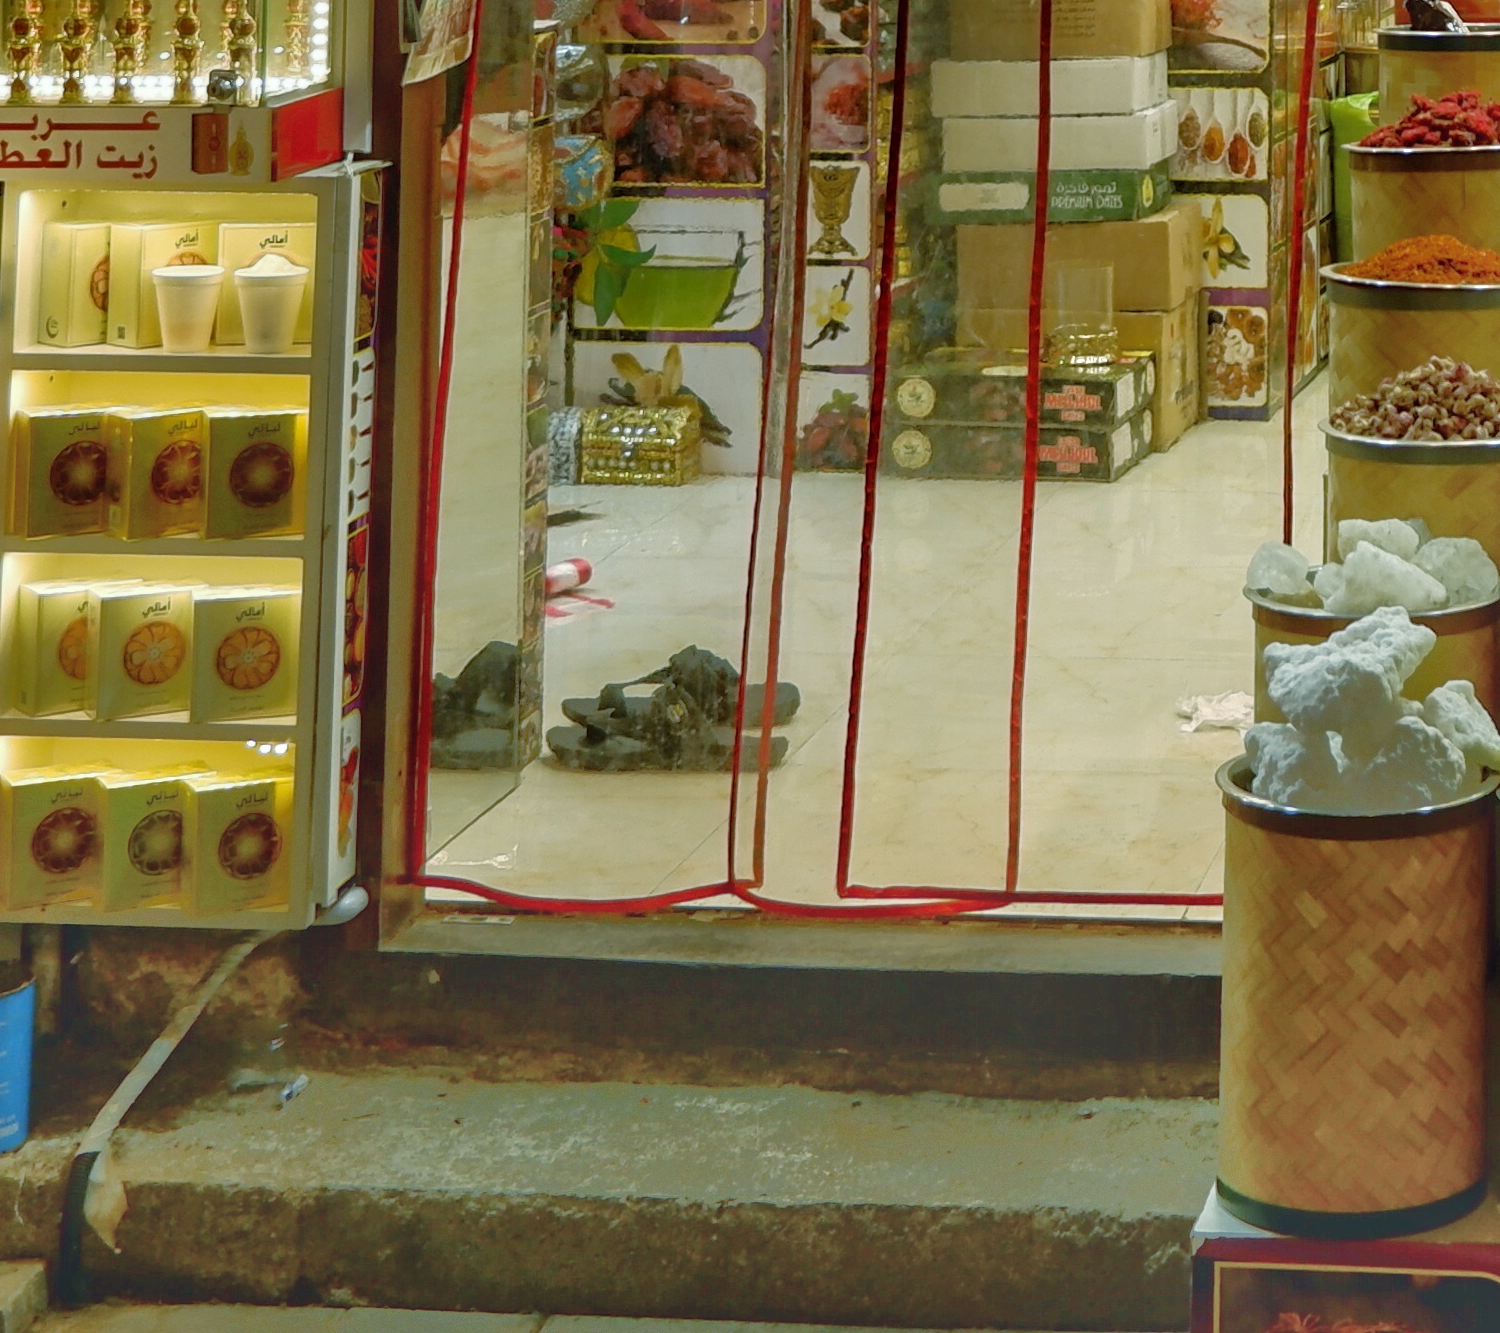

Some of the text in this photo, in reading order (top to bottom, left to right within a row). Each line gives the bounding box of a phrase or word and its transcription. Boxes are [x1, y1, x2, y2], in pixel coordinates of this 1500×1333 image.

[97, 144, 159, 180] زيت
[1051, 194, 1123, 209] PREMIUM DATES
[259, 230, 289, 249] أمالي
[141, 597, 171, 618] أمالي
[235, 602, 266, 623] أمالي
